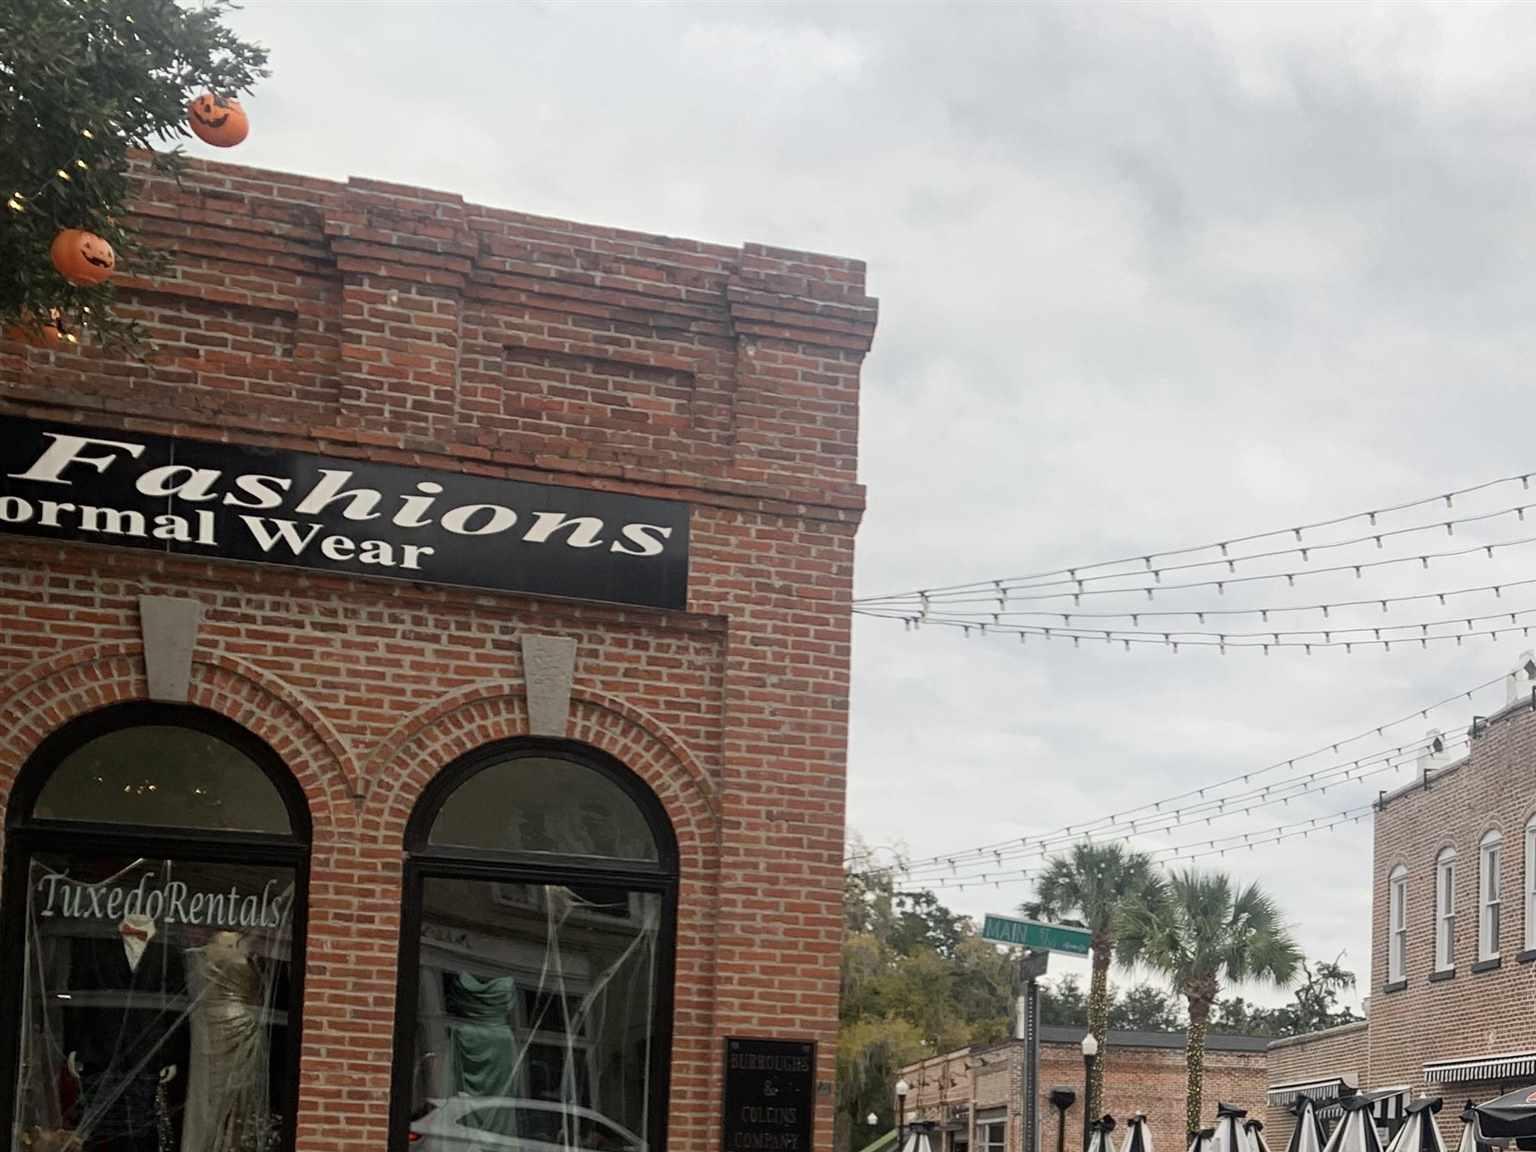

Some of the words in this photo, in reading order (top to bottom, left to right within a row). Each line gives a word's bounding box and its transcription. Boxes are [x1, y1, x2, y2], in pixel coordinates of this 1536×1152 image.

[7, 432, 673, 556] Fashions
[239, 514, 434, 571] Wear
[763, 1079, 778, 1096] &
